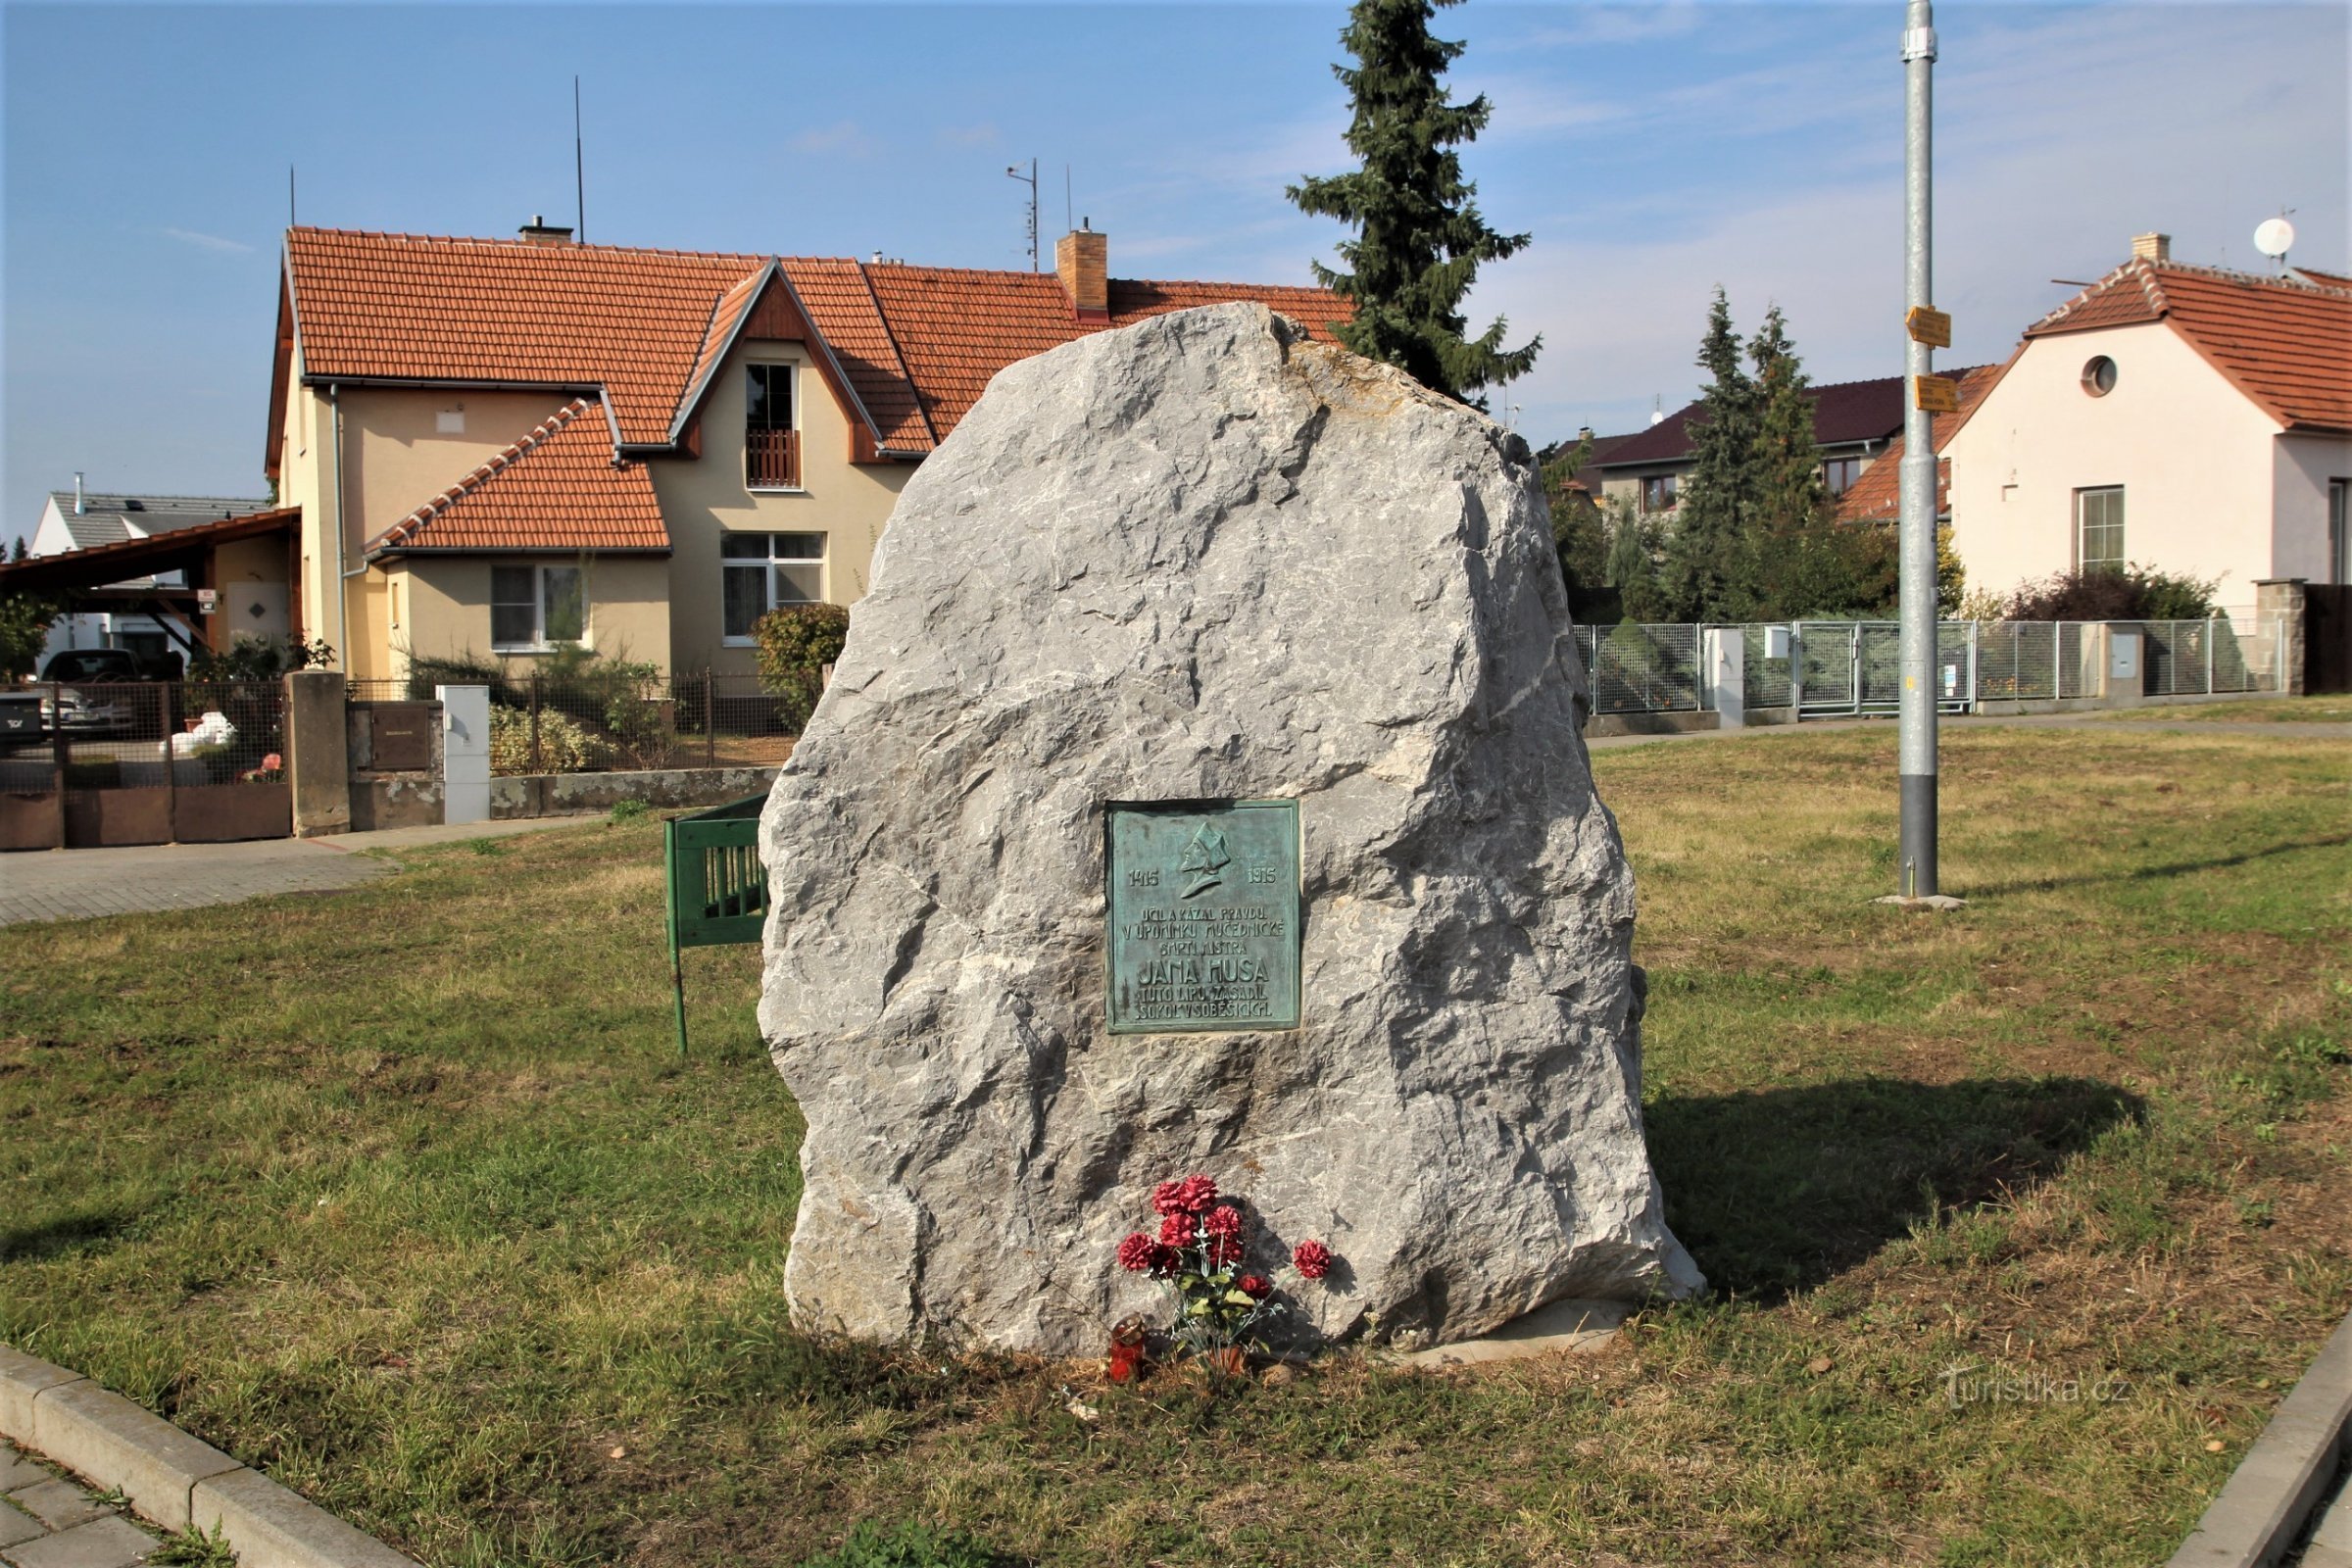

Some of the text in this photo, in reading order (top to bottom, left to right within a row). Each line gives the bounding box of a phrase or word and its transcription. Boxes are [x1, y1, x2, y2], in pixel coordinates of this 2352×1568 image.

[1129, 867, 1276, 886] 1415 1915
[1168, 909, 1177, 921] A
[1178, 906, 1216, 921] KÁZAL
[1122, 926, 1131, 940] V
[1204, 918, 1285, 938] MUČEDNICKÉ
[1159, 940, 1247, 956] SMRTI MISTRA
[1139, 957, 1270, 985] JANA HUSA
[1141, 988, 1173, 1004] TUTO
[1185, 1004, 1193, 1018] V
